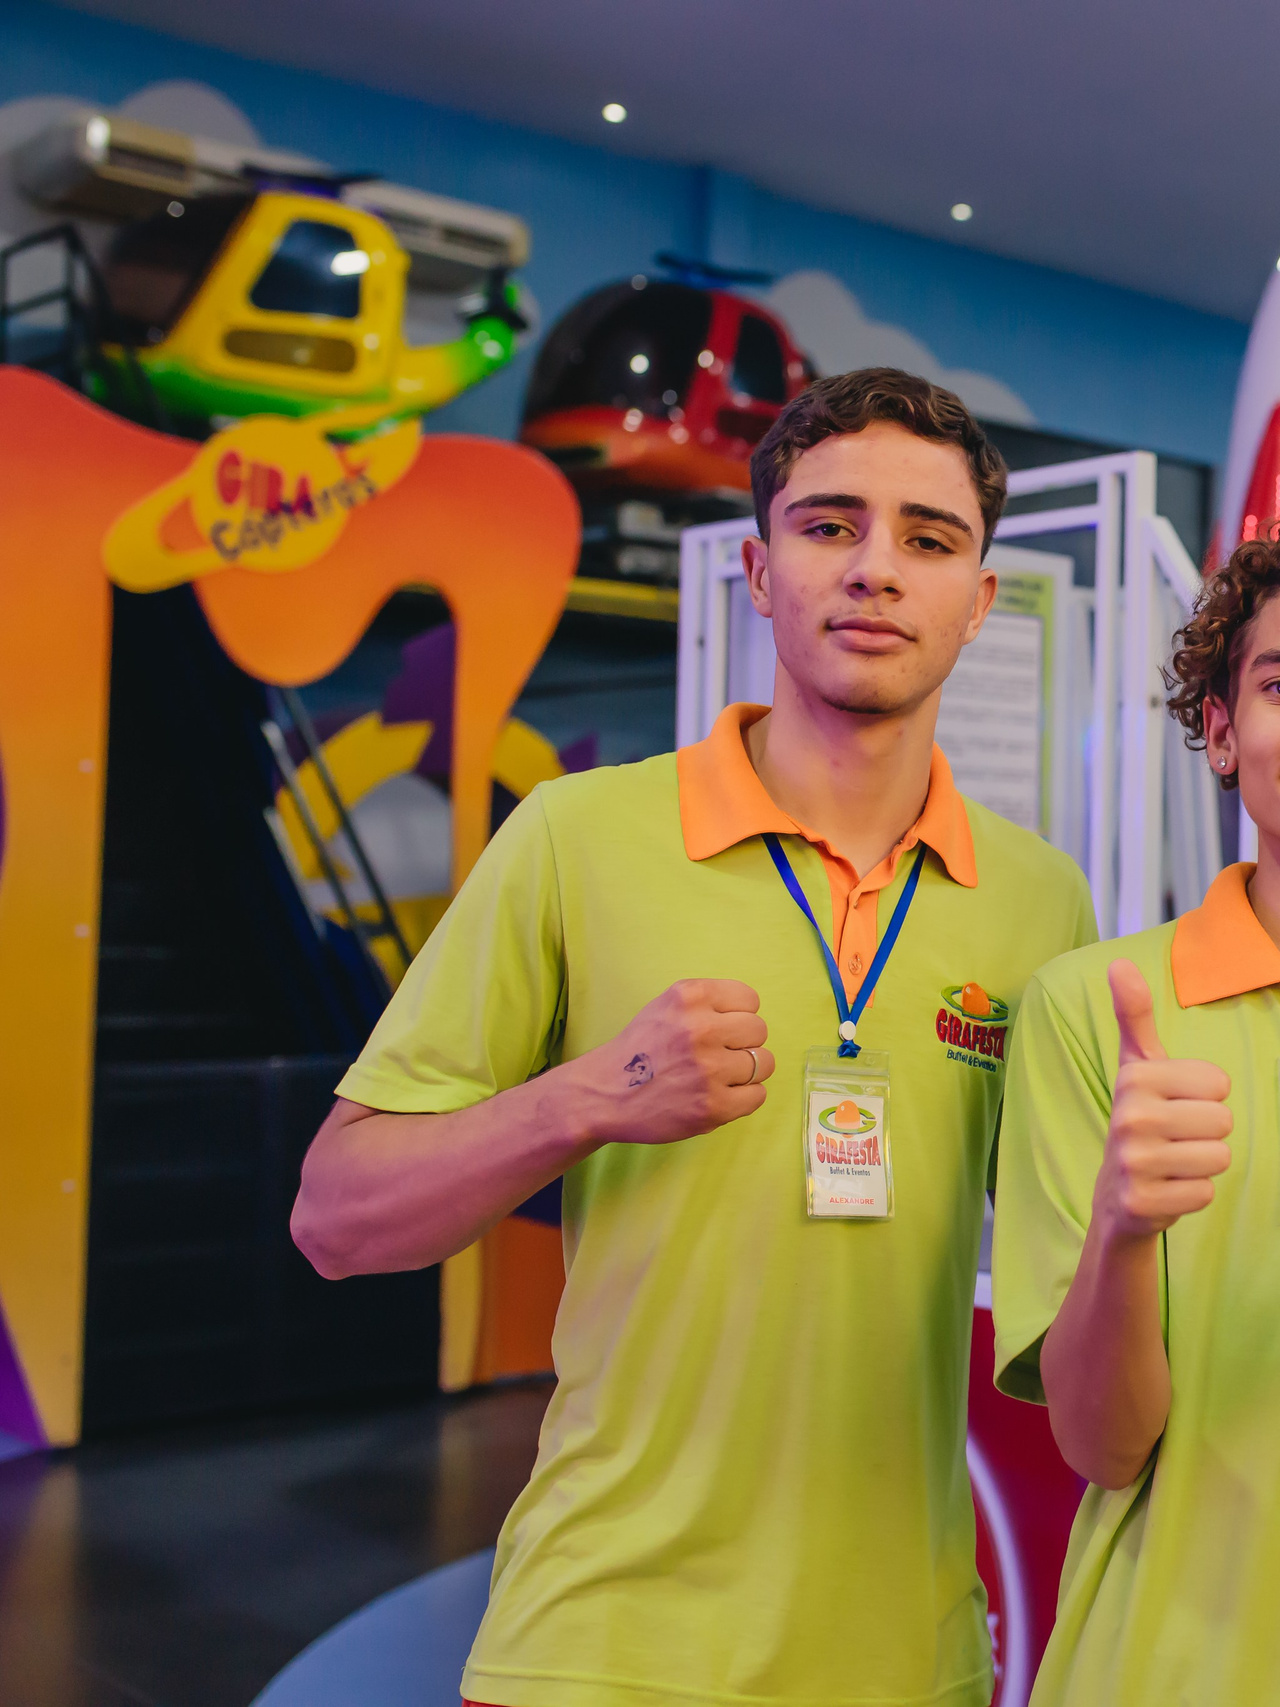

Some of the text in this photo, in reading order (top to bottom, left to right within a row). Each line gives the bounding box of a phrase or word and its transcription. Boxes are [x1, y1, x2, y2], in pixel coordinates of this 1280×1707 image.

[216, 449, 318, 519] GIRA
[815, 1132, 882, 1167] GIRAFESTA
[829, 1166, 871, 1177] Buffet & Eventos
[829, 1196, 875, 1205] ALEXANDRE
